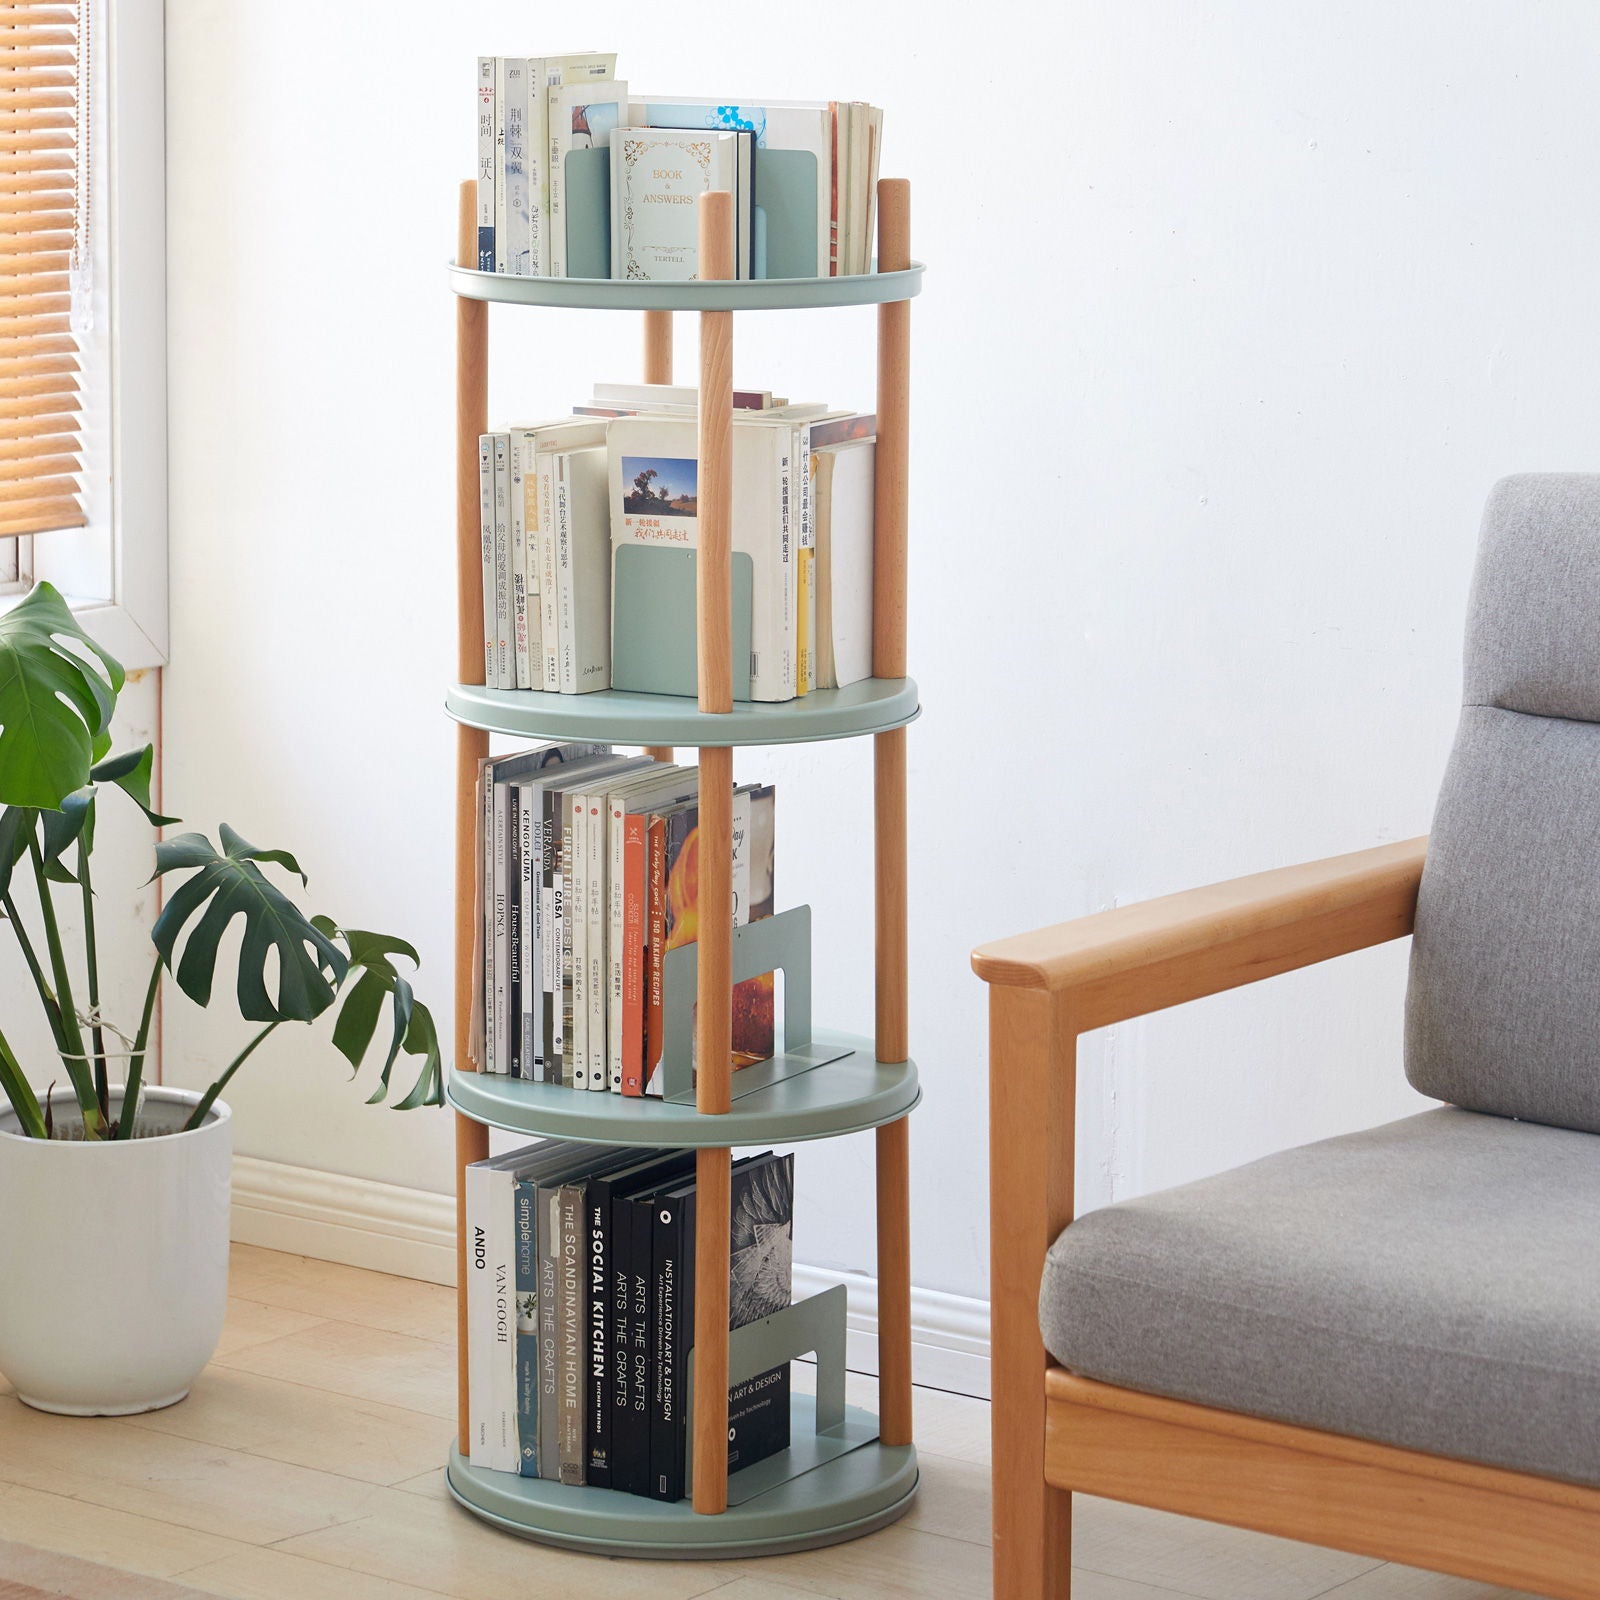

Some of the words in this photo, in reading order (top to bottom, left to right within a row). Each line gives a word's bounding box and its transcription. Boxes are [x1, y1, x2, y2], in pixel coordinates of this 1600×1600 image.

[480, 113, 492, 137] 时间
[480, 157, 493, 180] 证人
[653, 169, 682, 179] BOOK
[642, 194, 694, 205] ANSWERS
[801, 450, 809, 546] 什么公司最会赚钱
[534, 821, 542, 851] DOLCI
[543, 819, 553, 871] VERANDA
[564, 827, 572, 906] FURNITURE
[496, 893, 504, 937] HOPSCA
[564, 916, 572, 970] DESIGN
[652, 971, 660, 1007] RECIPES
[519, 1198, 532, 1275] simplehome
[565, 1204, 574, 1230] THE
[474, 1226, 486, 1270] ANDO
[592, 1229, 604, 1293] SOCIAL
[496, 1264, 506, 1294] VAN
[543, 1259, 554, 1298] ARTS
[565, 1234, 577, 1356] SCANDINAVIAN
[616, 1271, 627, 1310] ARTS
[636, 1275, 646, 1314] ARTS
[544, 1305, 555, 1332] THE
[664, 1259, 672, 1341] INSTALLATION
[496, 1298, 508, 1342] GOGH
[593, 1301, 604, 1378] KITCHEN
[616, 1316, 627, 1344] THE
[635, 1321, 646, 1348] THE
[544, 1338, 555, 1394] CRAFTS
[656, 1352, 664, 1361] by
[664, 1343, 672, 1363] ART
[664, 1366, 672, 1375] &
[566, 1361, 577, 1409] HOME
[616, 1350, 627, 1407] CRAFTS
[634, 1355, 645, 1412] CRAFTS
[734, 1386, 747, 1400] ART
[748, 1384, 754, 1395] &
[755, 1372, 782, 1391] DESIGN
[664, 1378, 672, 1421] DESIGN
[746, 1399, 772, 1413] Technology
